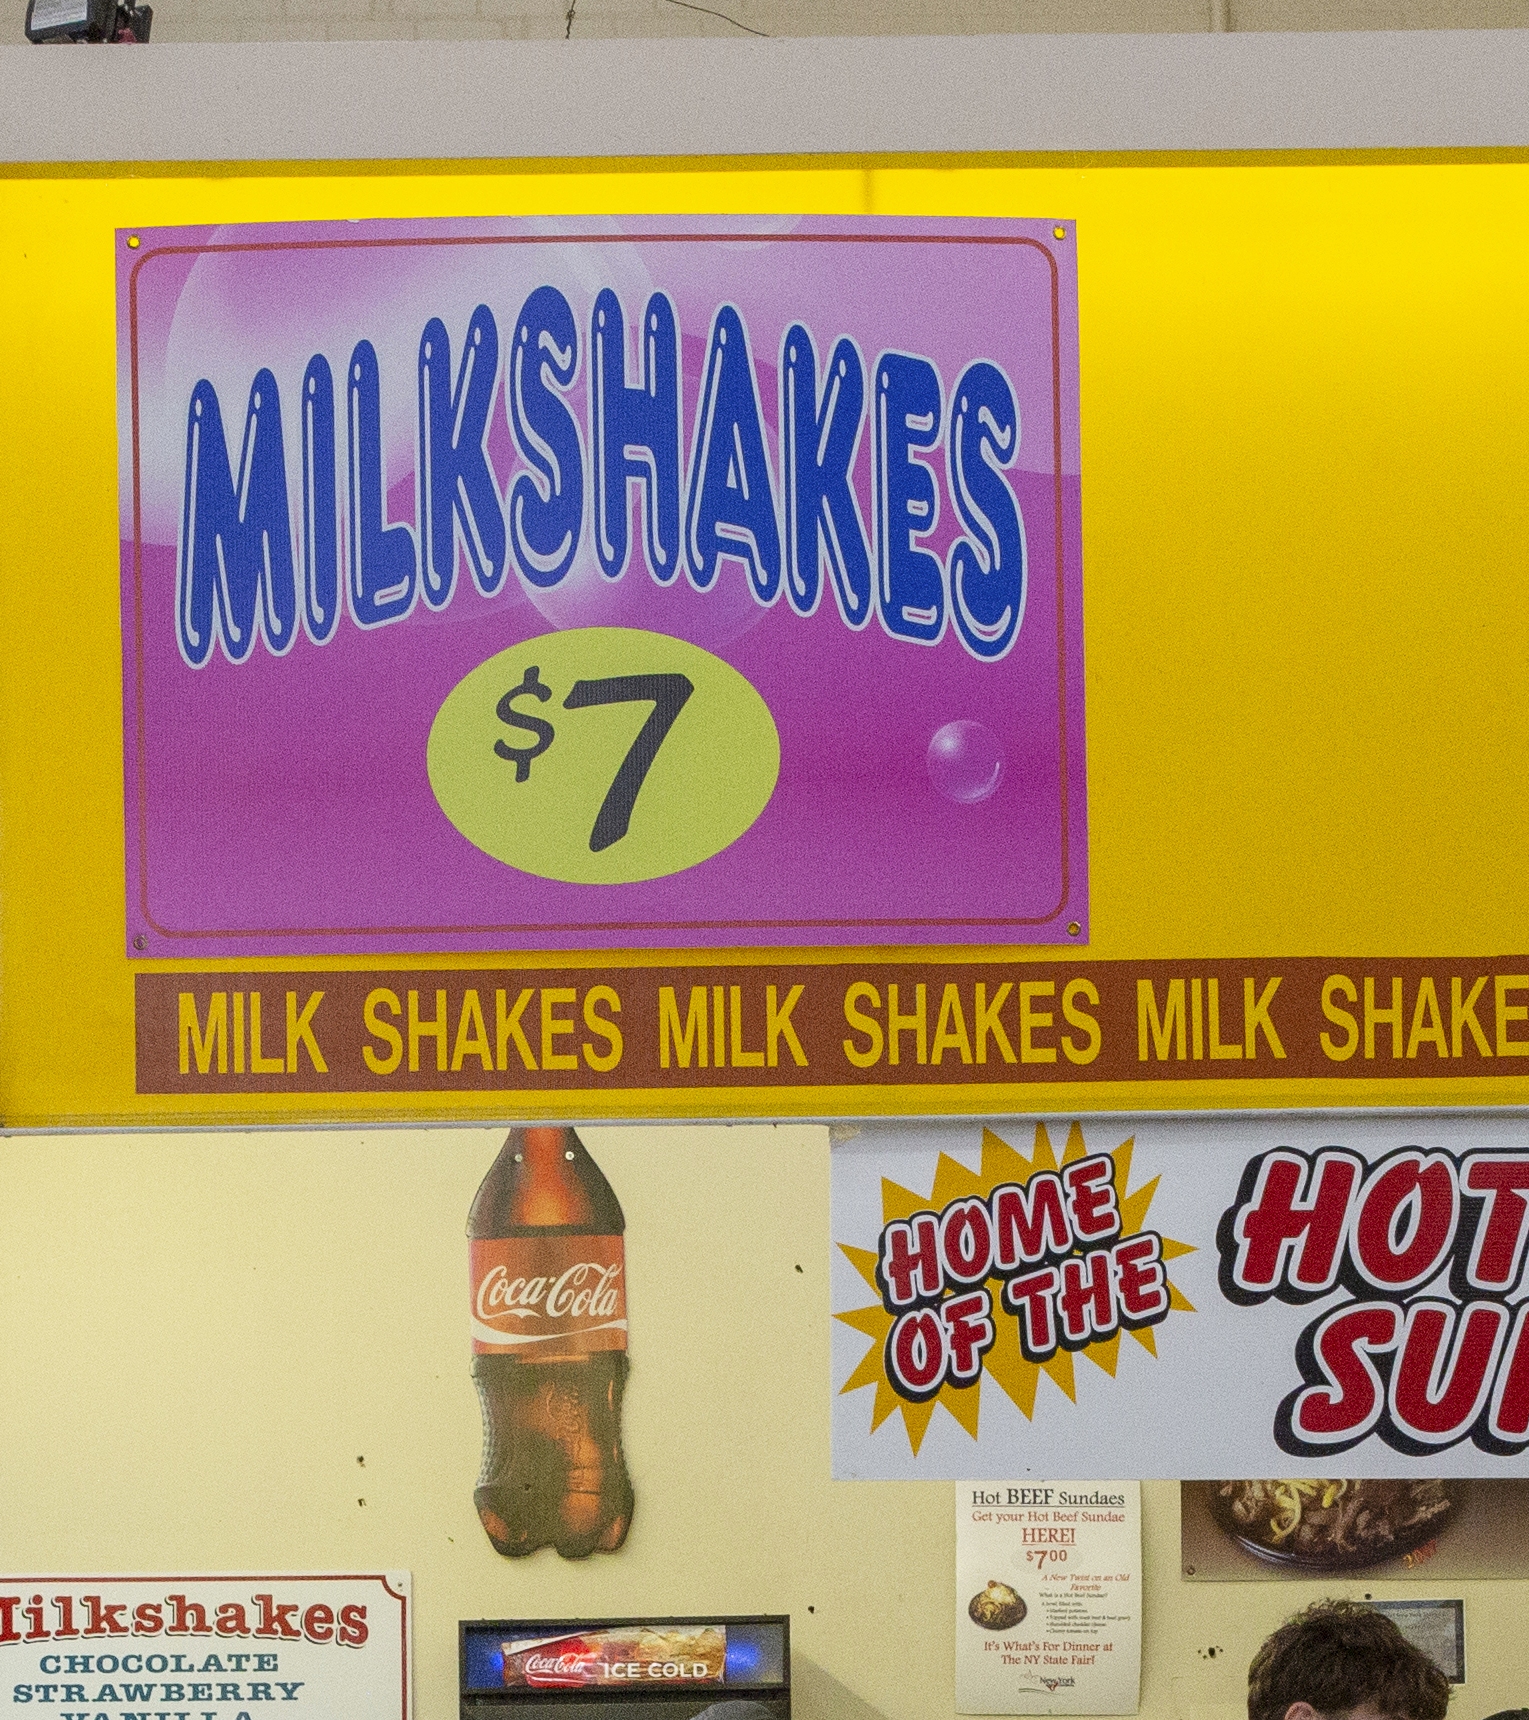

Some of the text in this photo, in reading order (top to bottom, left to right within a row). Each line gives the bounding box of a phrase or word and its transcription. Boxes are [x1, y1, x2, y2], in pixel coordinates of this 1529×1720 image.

[174, 284, 1028, 669] MILKSHAKES
[493, 665, 696, 855] $7
[177, 989, 327, 1075] MILK
[362, 985, 623, 1074] SHAKES
[658, 983, 808, 1070] MILK
[842, 979, 1101, 1067] SHAKES
[1137, 976, 1287, 1062] MILK
[877, 1152, 1122, 1305] HOME
[476, 1261, 619, 1320] Coca-Cola
[886, 1231, 1170, 1402] OF THE
[972, 1488, 1125, 1505] Hot BEEF Sundaes
[972, 1510, 1125, 1524] Get your Hot Beef Sundae
[1022, 1527, 1075, 1543] HERE!
[984, 1641, 1113, 1651] It's What's For Dinner at
[39, 1653, 279, 1674] CHOCOLATE
[603, 1662, 640, 1678] ICE
[648, 1662, 708, 1678] COLD
[1001, 1655, 1020, 1665] The
[1024, 1655, 1040, 1665] NY
[1043, 1655, 1068, 1665] State
[13, 1682, 304, 1703] STRAWBERRY
